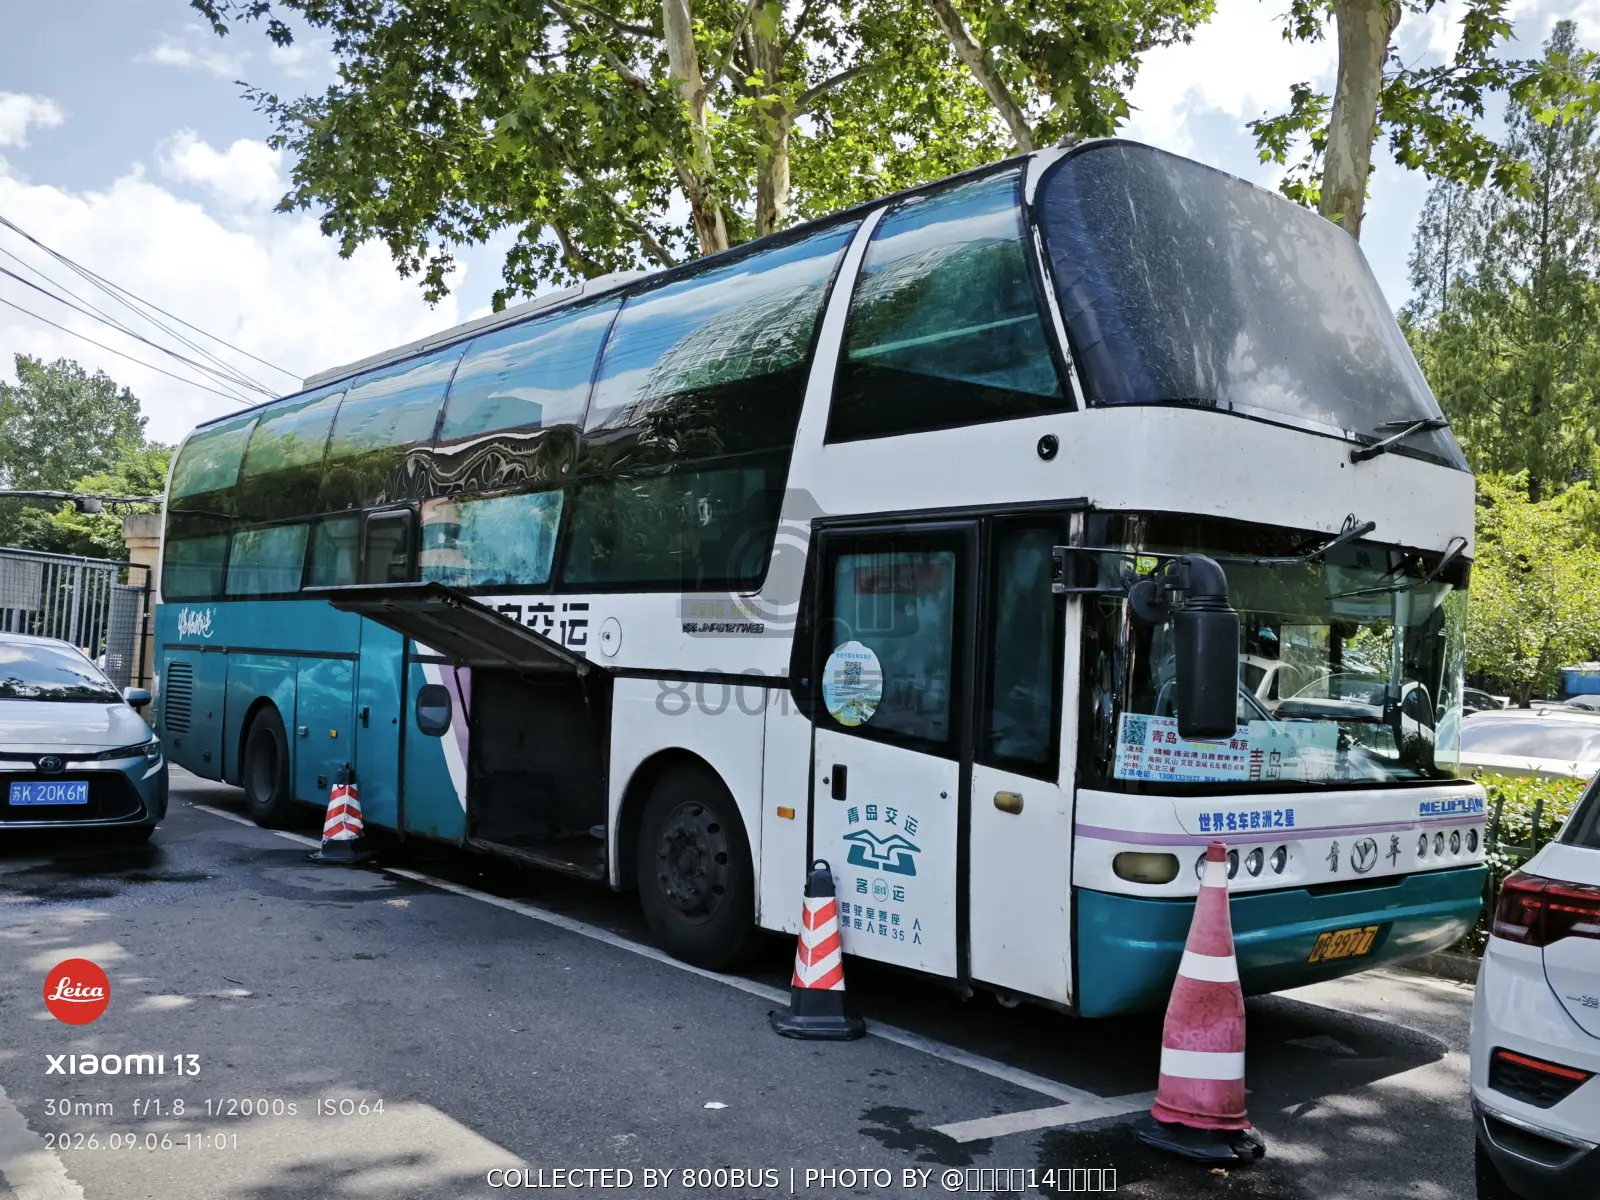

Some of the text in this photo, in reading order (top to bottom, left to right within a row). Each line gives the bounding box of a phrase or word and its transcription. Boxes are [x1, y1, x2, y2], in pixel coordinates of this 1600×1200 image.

[1151, 729, 1177, 744] 青岛
[1229, 738, 1249, 751] 南京
[847, 804, 919, 837] 青岛交运
[1198, 808, 1295, 833] 世界名车欧洲之星
